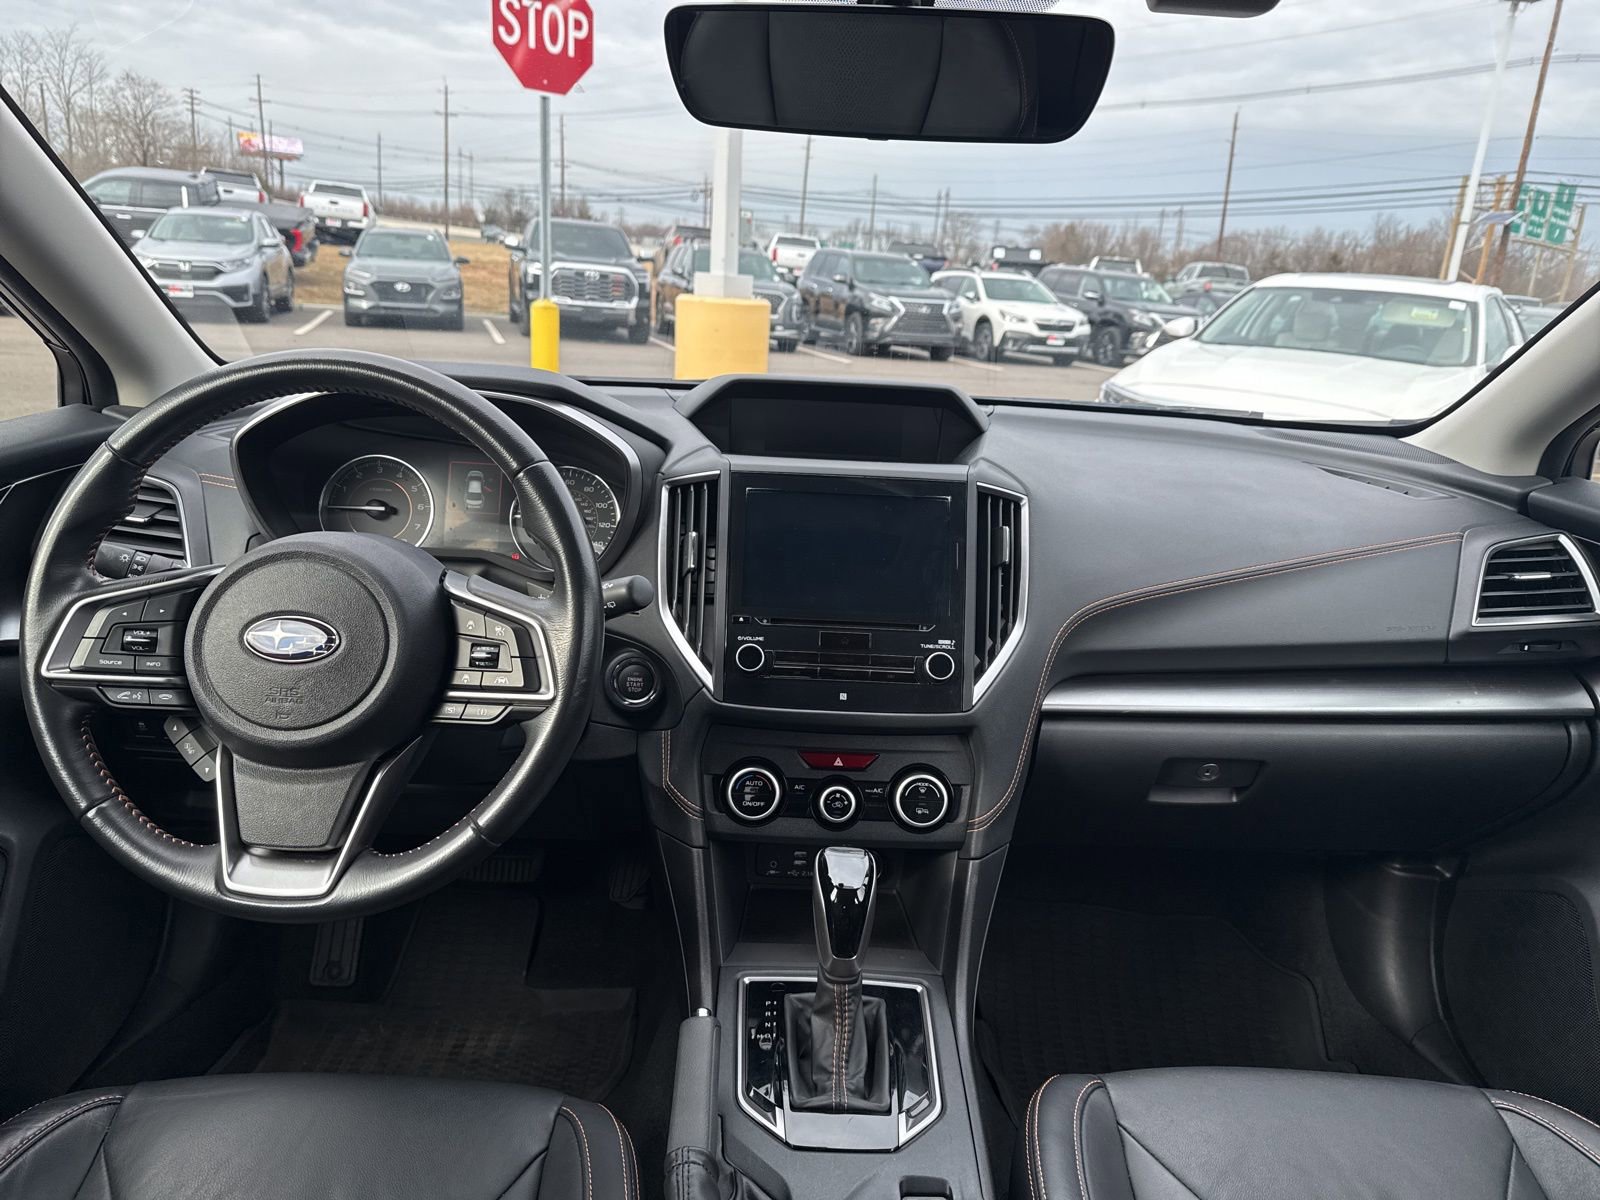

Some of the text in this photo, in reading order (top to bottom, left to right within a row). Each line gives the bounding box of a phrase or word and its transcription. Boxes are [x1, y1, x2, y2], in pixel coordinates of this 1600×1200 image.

[497, 0, 590, 58] STOP
[411, 485, 419, 493] 5
[417, 503, 425, 511] 6
[595, 501, 608, 509] 100
[414, 523, 421, 531] 7
